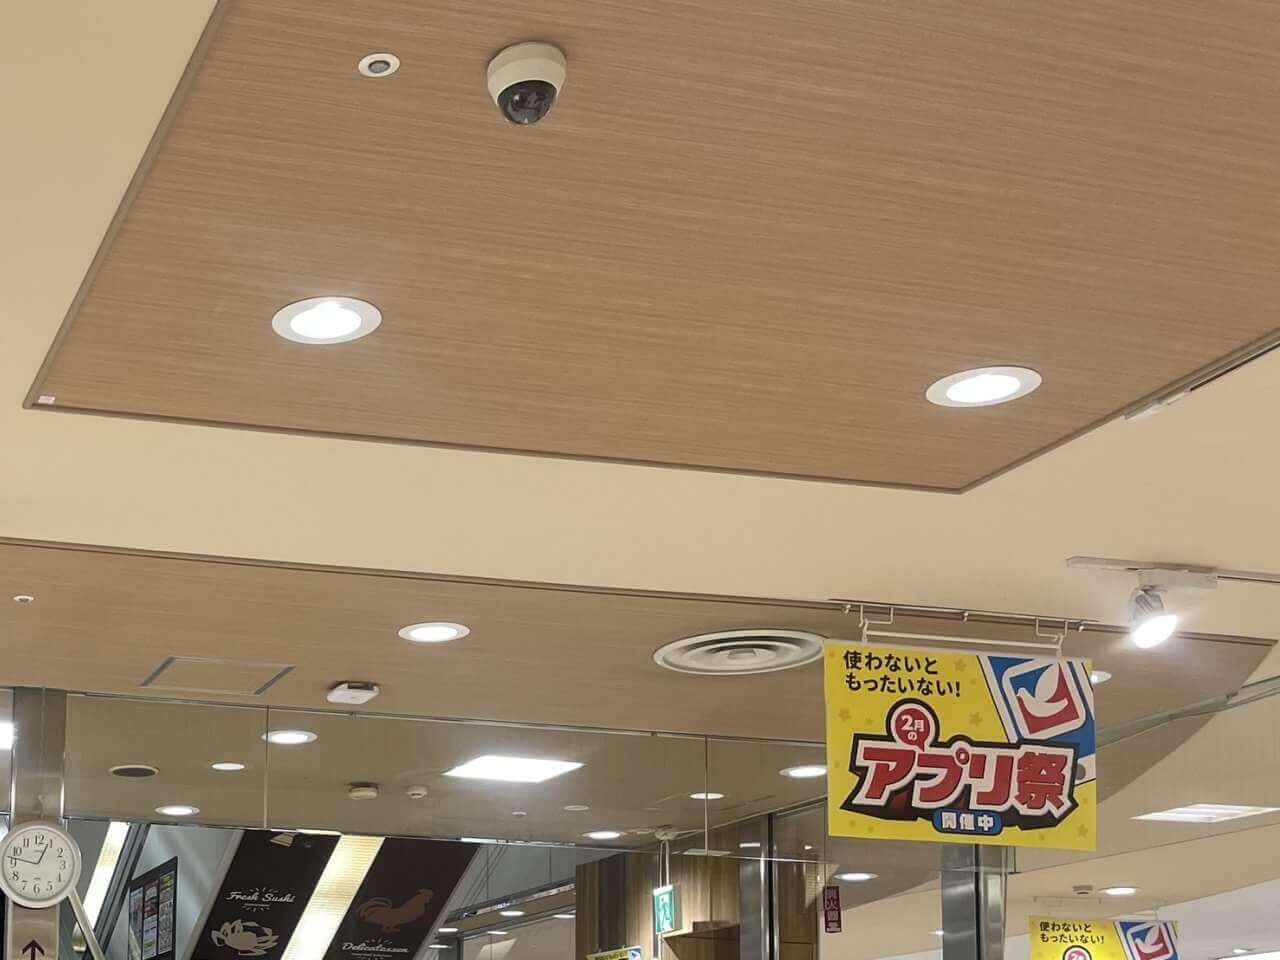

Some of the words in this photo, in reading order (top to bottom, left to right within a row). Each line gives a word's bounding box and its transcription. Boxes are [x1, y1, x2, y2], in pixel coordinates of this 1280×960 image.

[844, 650, 939, 675] 使わないと
[845, 672, 961, 697] もったいない!
[901, 715, 925, 732] 2月
[862, 747, 1068, 811] アプリ祭
[941, 812, 994, 832] 開催中
[225, 890, 259, 903] Fresh
[261, 891, 296, 903] Sushi
[1040, 921, 1093, 933] 使わないと
[342, 941, 410, 954] Delicatessen
